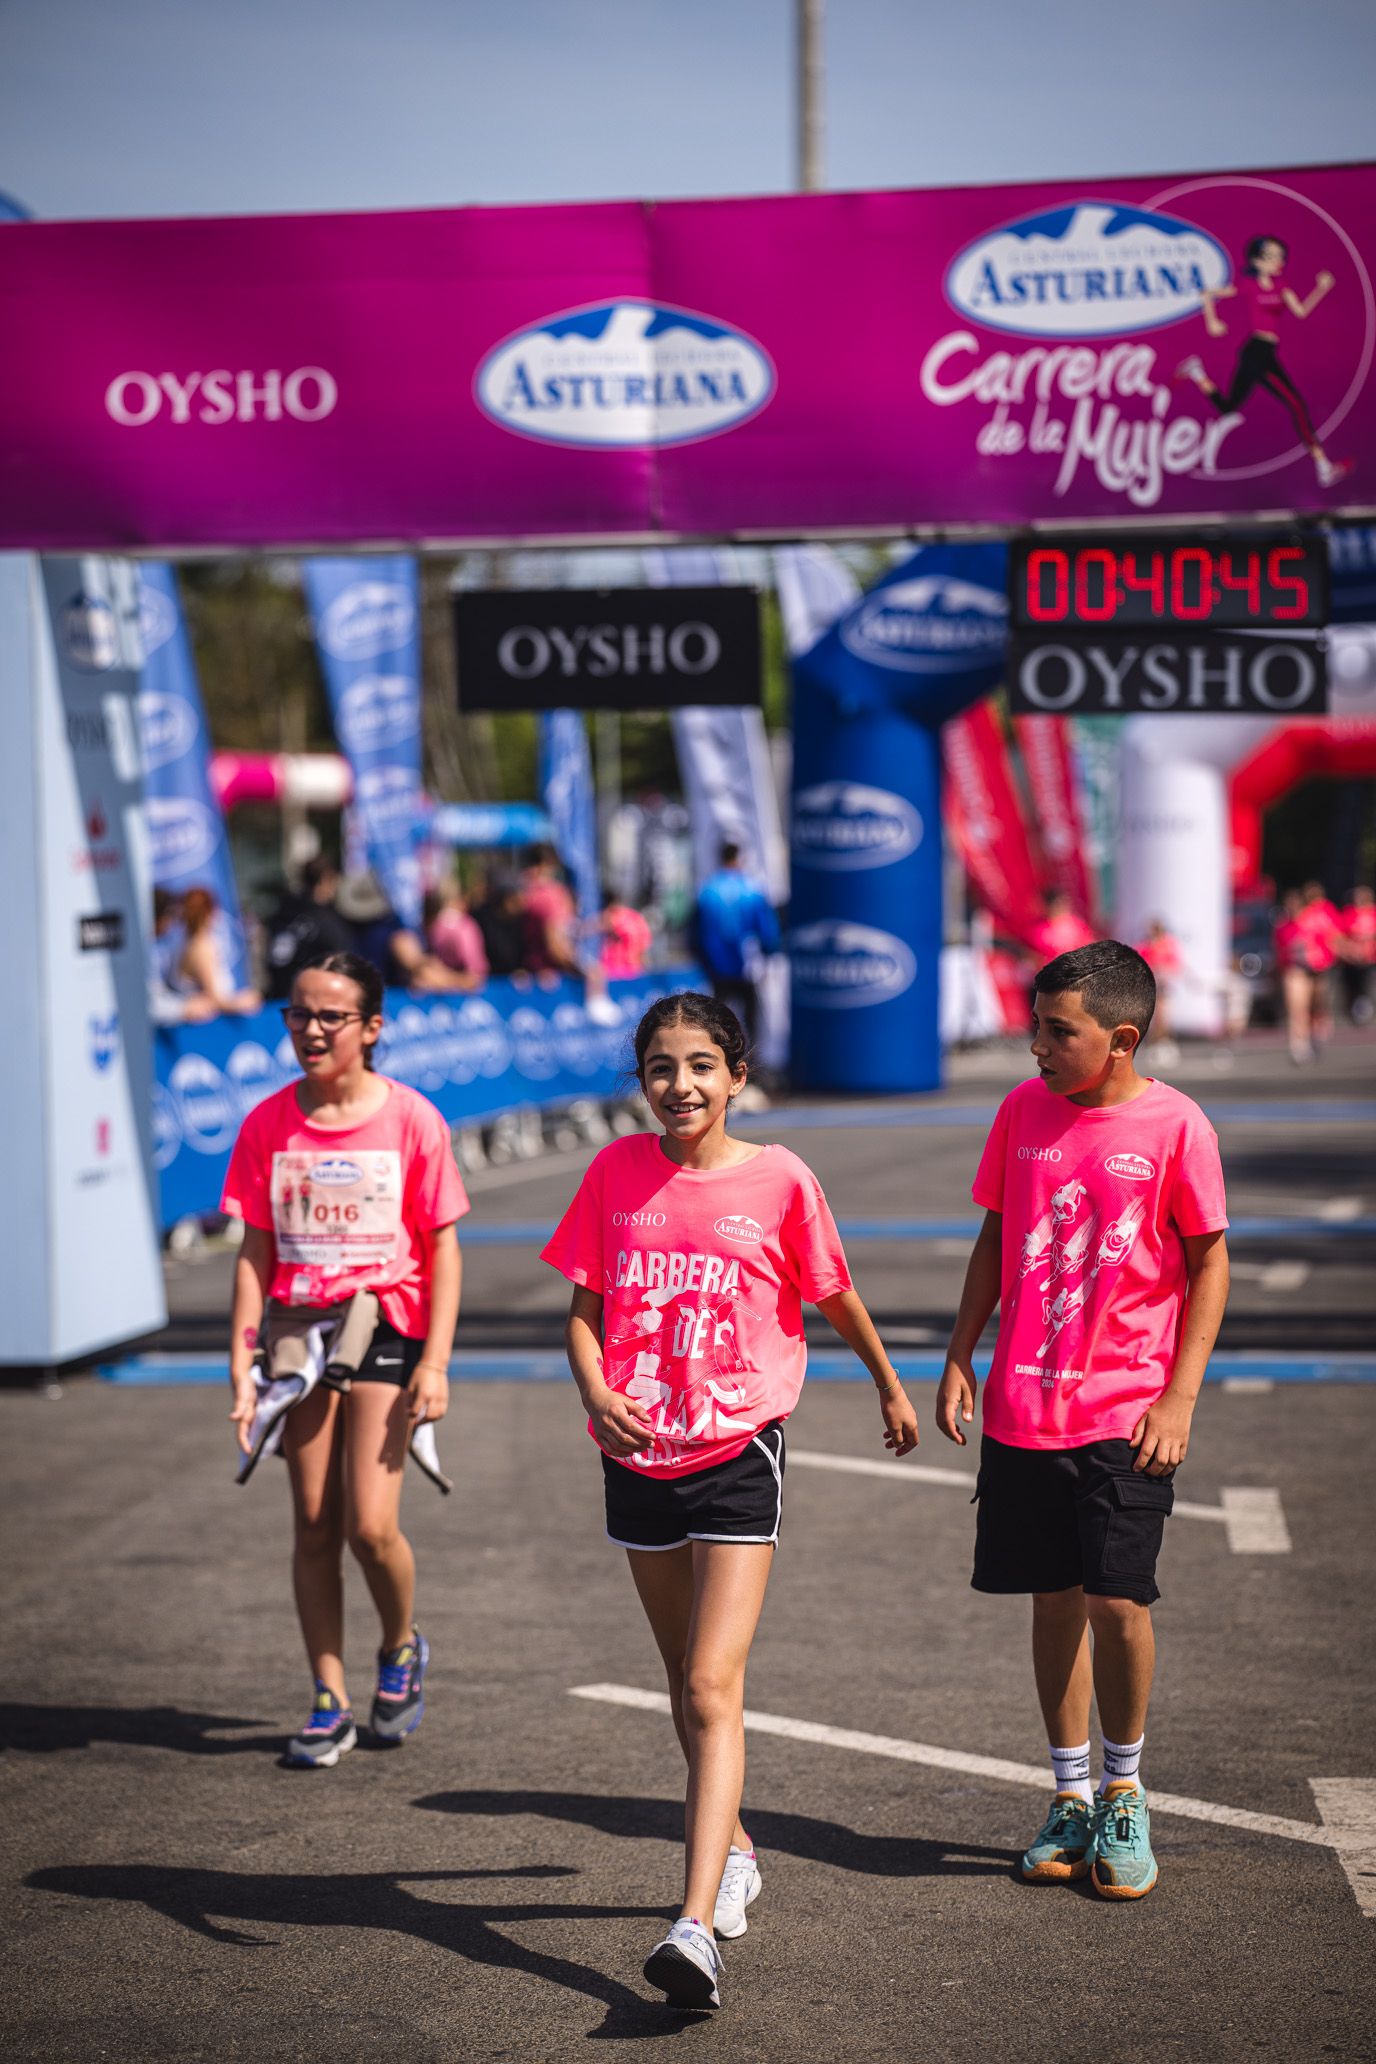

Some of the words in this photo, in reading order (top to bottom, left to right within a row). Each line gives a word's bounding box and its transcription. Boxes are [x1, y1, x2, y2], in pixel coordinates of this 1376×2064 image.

[967, 254, 1206, 306] ASTURIANA
[503, 354, 748, 410] ASTURIANA
[919, 330, 1157, 405] Carrera
[104, 365, 338, 426] OYSHO
[975, 401, 1025, 455] de
[1028, 400, 1065, 453] la
[1053, 386, 1245, 507] Mujer
[1026, 548, 1309, 621] 00:40:45
[497, 620, 722, 680] OYSHO
[1019, 644, 1316, 710] OYSHO
[1018, 1147, 1062, 1162] OYSHO
[1108, 1159, 1151, 1177] ASTURIANA
[314, 1203, 359, 1223] 016
[612, 1212, 667, 1227] OYSHO
[718, 1221, 761, 1241] ASTURIANA
[615, 1249, 741, 1296] CARRERA
[671, 1304, 715, 1359] DE
[1015, 1364, 1044, 1376] CARRERA
[1052, 1370, 1060, 1378] LA
[1061, 1370, 1083, 1380] MUJER
